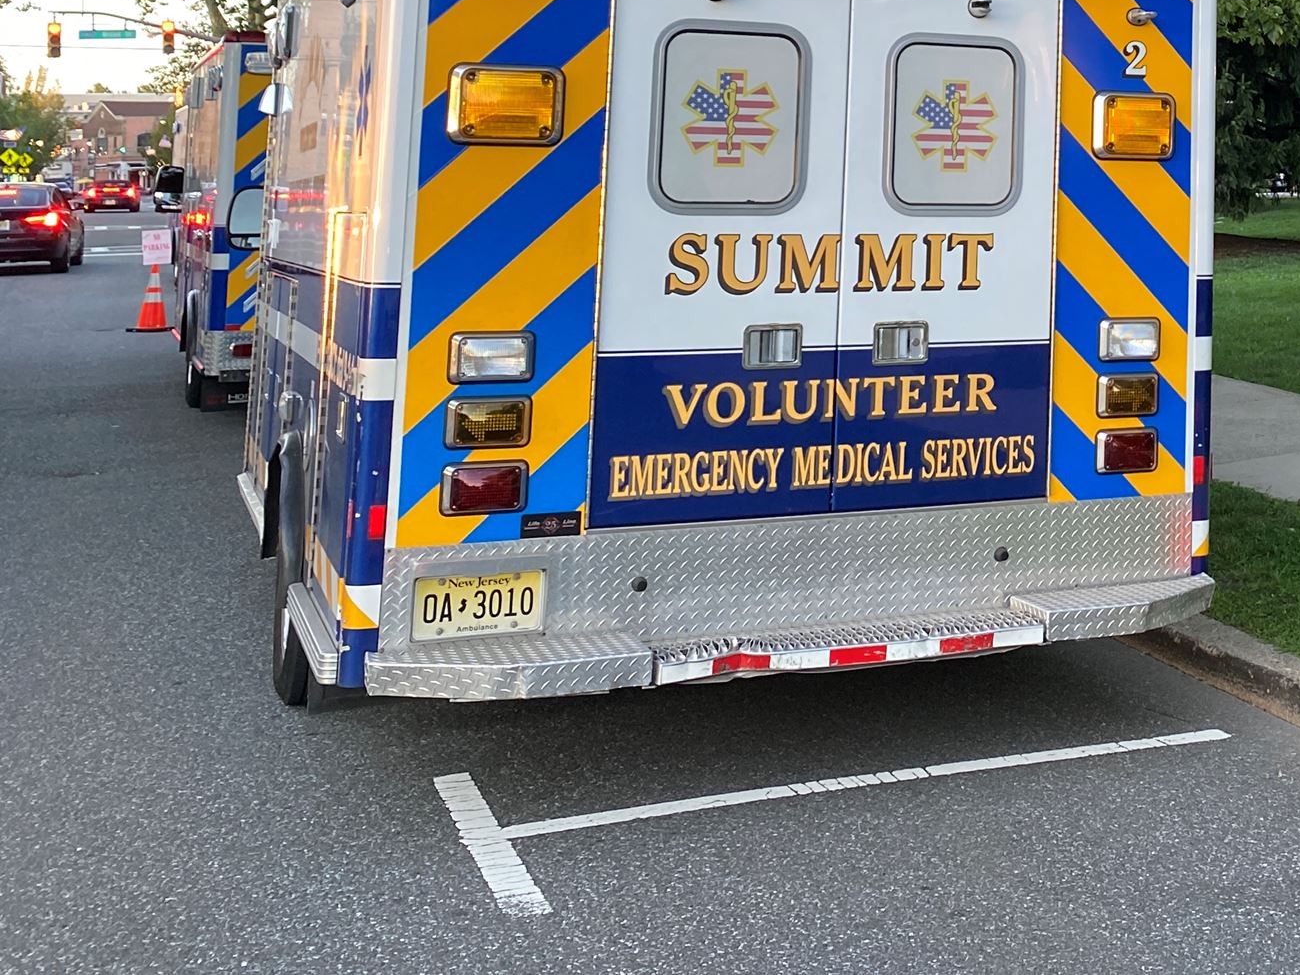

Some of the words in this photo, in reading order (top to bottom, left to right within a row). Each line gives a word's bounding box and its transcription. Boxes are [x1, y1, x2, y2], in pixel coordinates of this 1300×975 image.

[1122, 40, 1147, 78] 2
[143, 243, 170, 251] PARKING
[665, 232, 995, 295] SUMMIT
[663, 372, 997, 430] VOLUNTEER
[607, 447, 785, 503] EMERGENCY
[793, 442, 914, 489] MEDICAL
[920, 434, 1036, 480] SERVICES
[448, 578, 475, 589] New
[476, 576, 511, 589] Jersey
[473, 587, 533, 619] 3010
[456, 624, 498, 633] Ambulance
